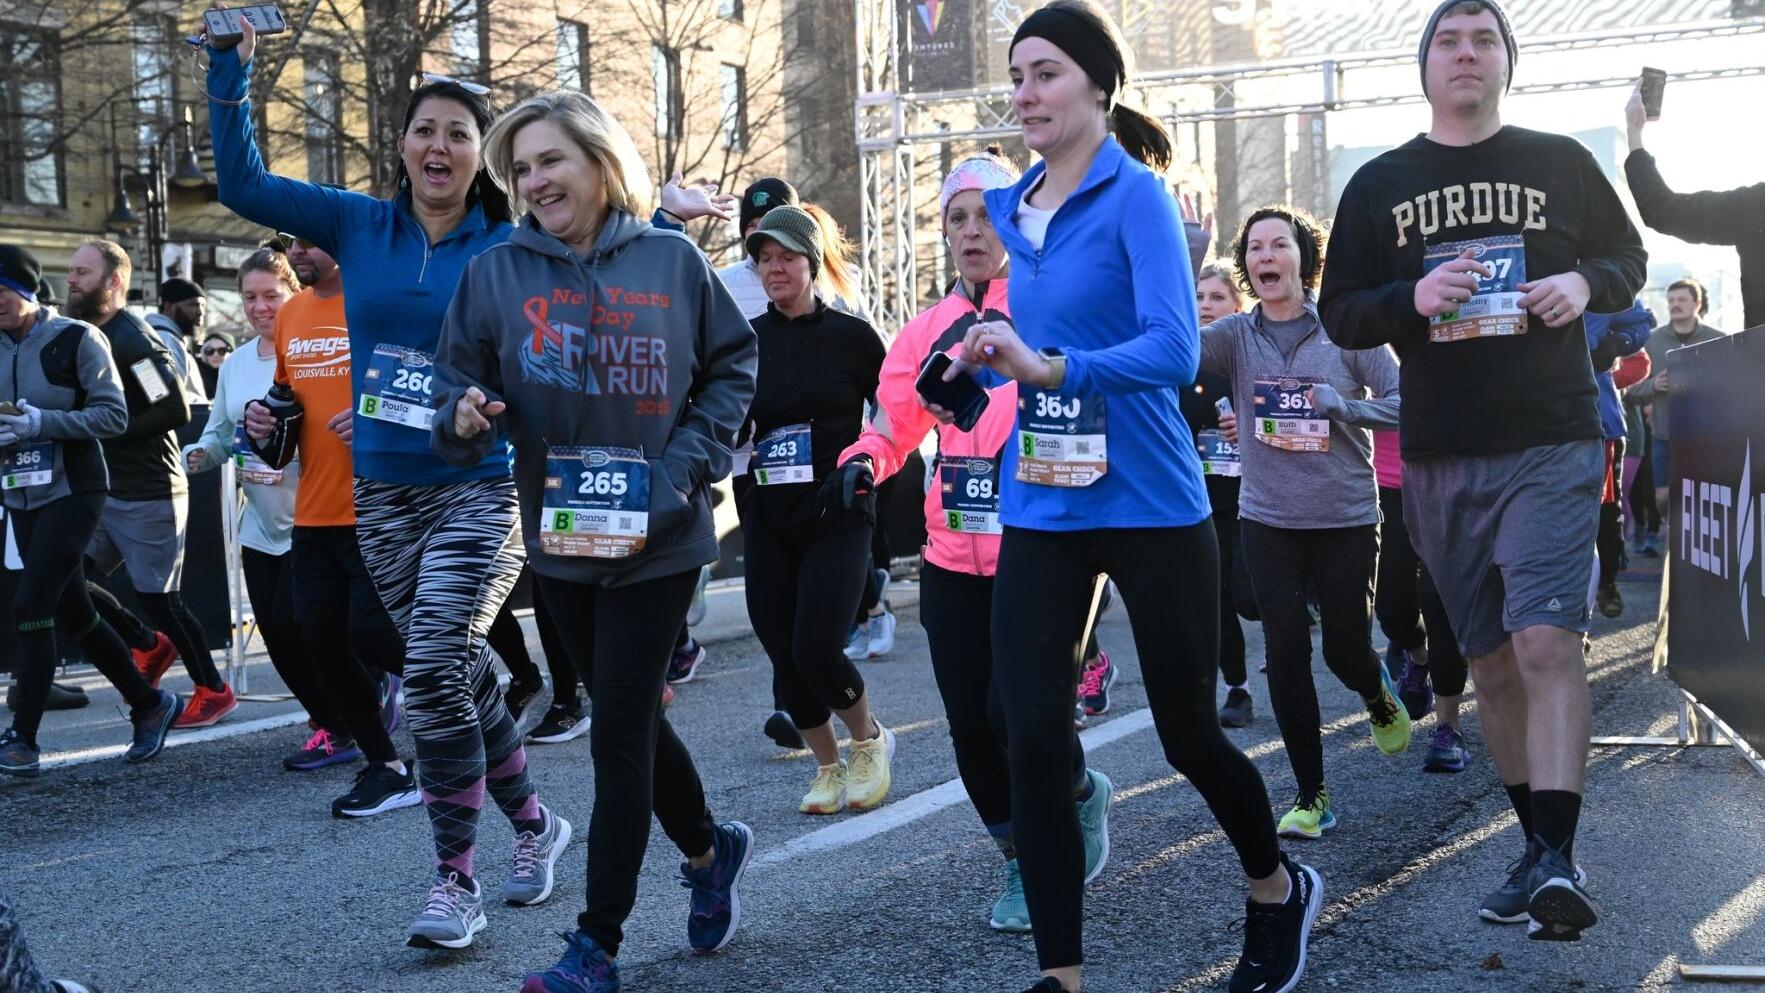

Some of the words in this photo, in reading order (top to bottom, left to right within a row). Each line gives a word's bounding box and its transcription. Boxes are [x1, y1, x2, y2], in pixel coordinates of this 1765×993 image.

[1391, 182, 1547, 248] PURDUE
[606, 287, 672, 308] Years
[592, 304, 636, 332] Day
[287, 336, 350, 357] Swags
[608, 365, 668, 395] RUN
[365, 397, 377, 414] B
[1279, 392, 1313, 409] 361
[1264, 421, 1273, 433] B
[767, 441, 798, 458] 263
[1023, 435, 1032, 456] B
[1034, 437, 1060, 449] Sarah
[16, 450, 41, 465] 366
[578, 471, 628, 496] 265
[555, 512, 570, 530] B
[575, 513, 607, 523] Donna
[949, 512, 959, 529] B
[962, 514, 985, 523] Dana
[1682, 478, 1732, 581] FLEET
